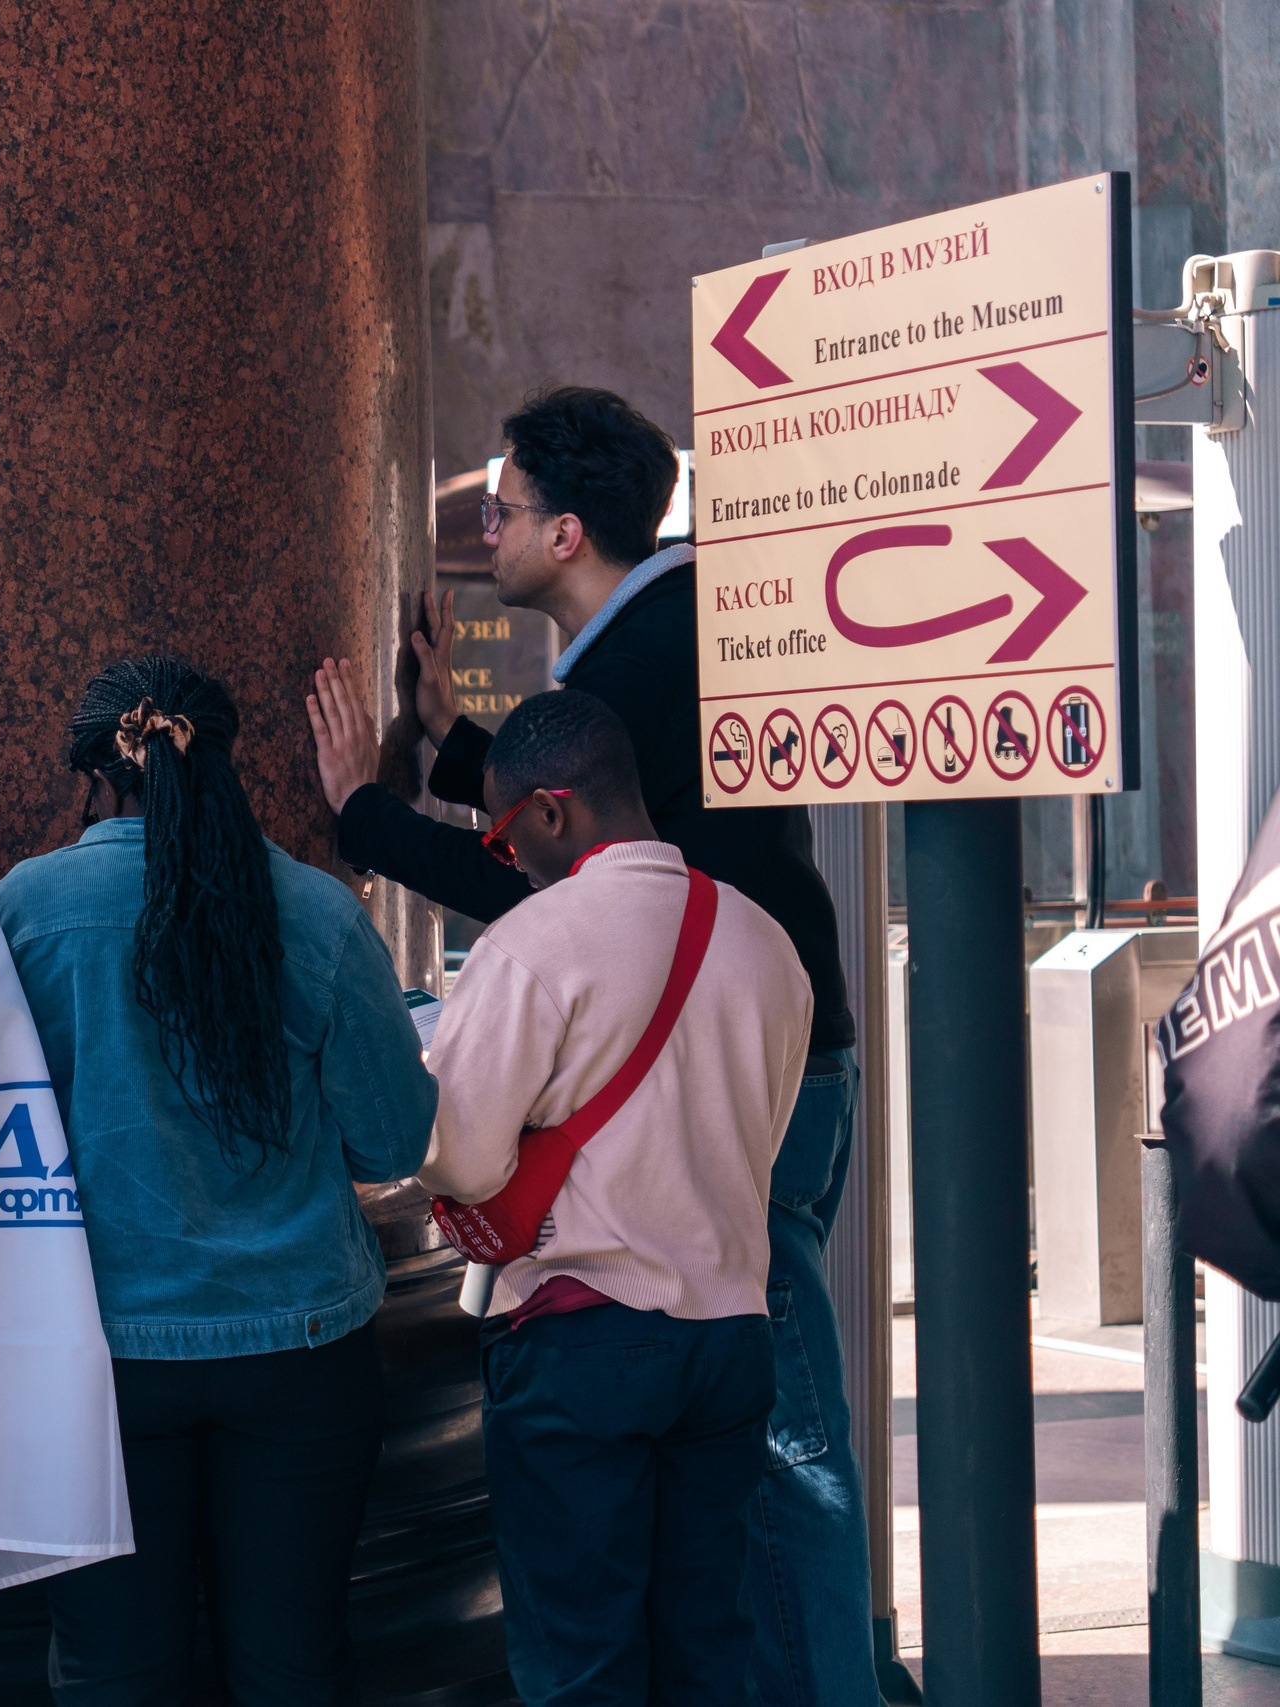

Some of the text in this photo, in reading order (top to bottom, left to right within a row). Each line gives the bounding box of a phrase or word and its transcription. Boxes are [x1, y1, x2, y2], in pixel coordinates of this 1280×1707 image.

[813, 221, 990, 296] ВХОД В МУЗЕЙ
[814, 293, 1064, 365] Entrance to the Museum
[710, 384, 962, 456] ВХОД НА КОЛОННАДУ
[711, 461, 961, 523] Entrance to the Colonnade
[715, 577, 794, 612] КАССЫ
[454, 616, 510, 639] УЗЕЙ
[718, 629, 827, 662] Ticket office
[452, 668, 493, 688] NCE
